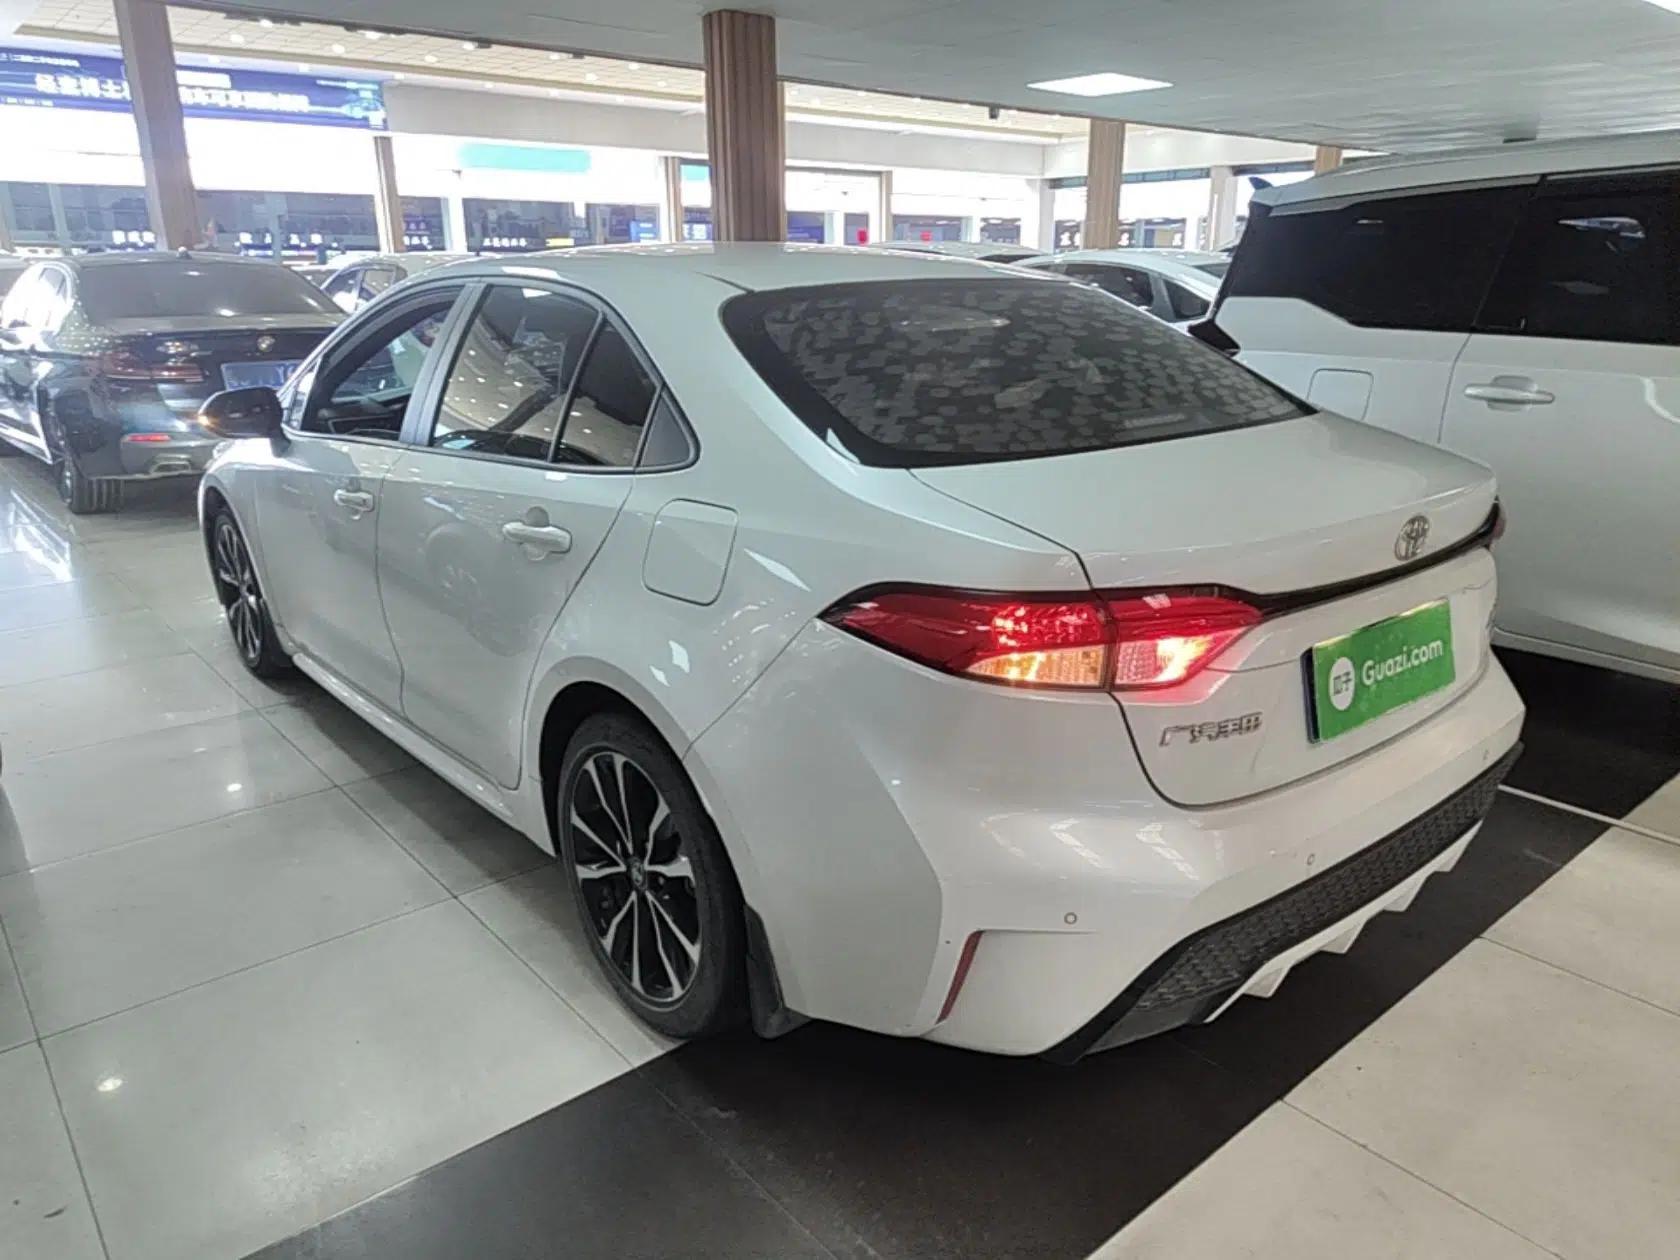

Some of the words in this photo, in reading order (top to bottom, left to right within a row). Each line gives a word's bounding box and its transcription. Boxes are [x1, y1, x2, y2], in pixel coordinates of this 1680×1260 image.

[1362, 640, 1443, 686] Guazi.com
[1159, 711, 1263, 747] 广汽丰田
